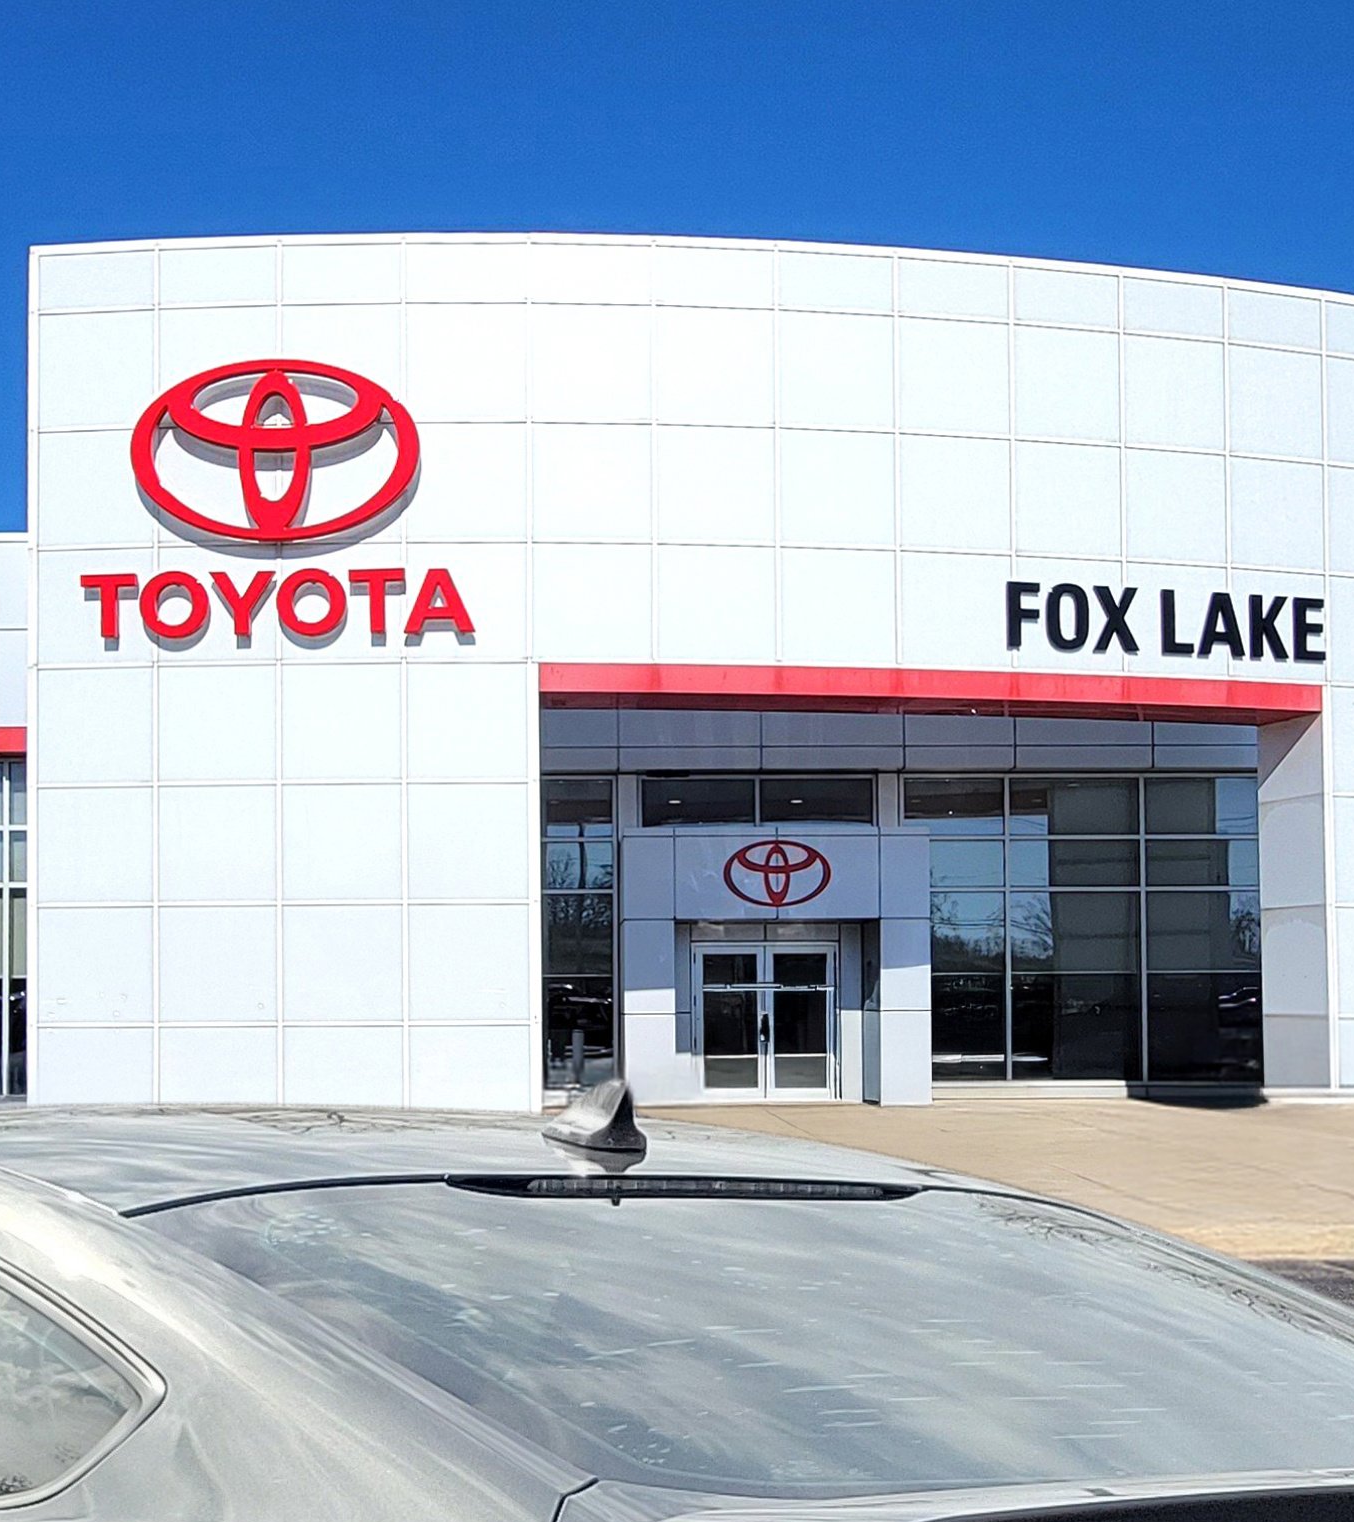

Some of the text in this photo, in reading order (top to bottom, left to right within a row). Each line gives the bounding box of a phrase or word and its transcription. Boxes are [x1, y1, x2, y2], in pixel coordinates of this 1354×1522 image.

[80, 568, 476, 640] TOYOTA
[1005, 581, 1327, 661] FOX LAKE
